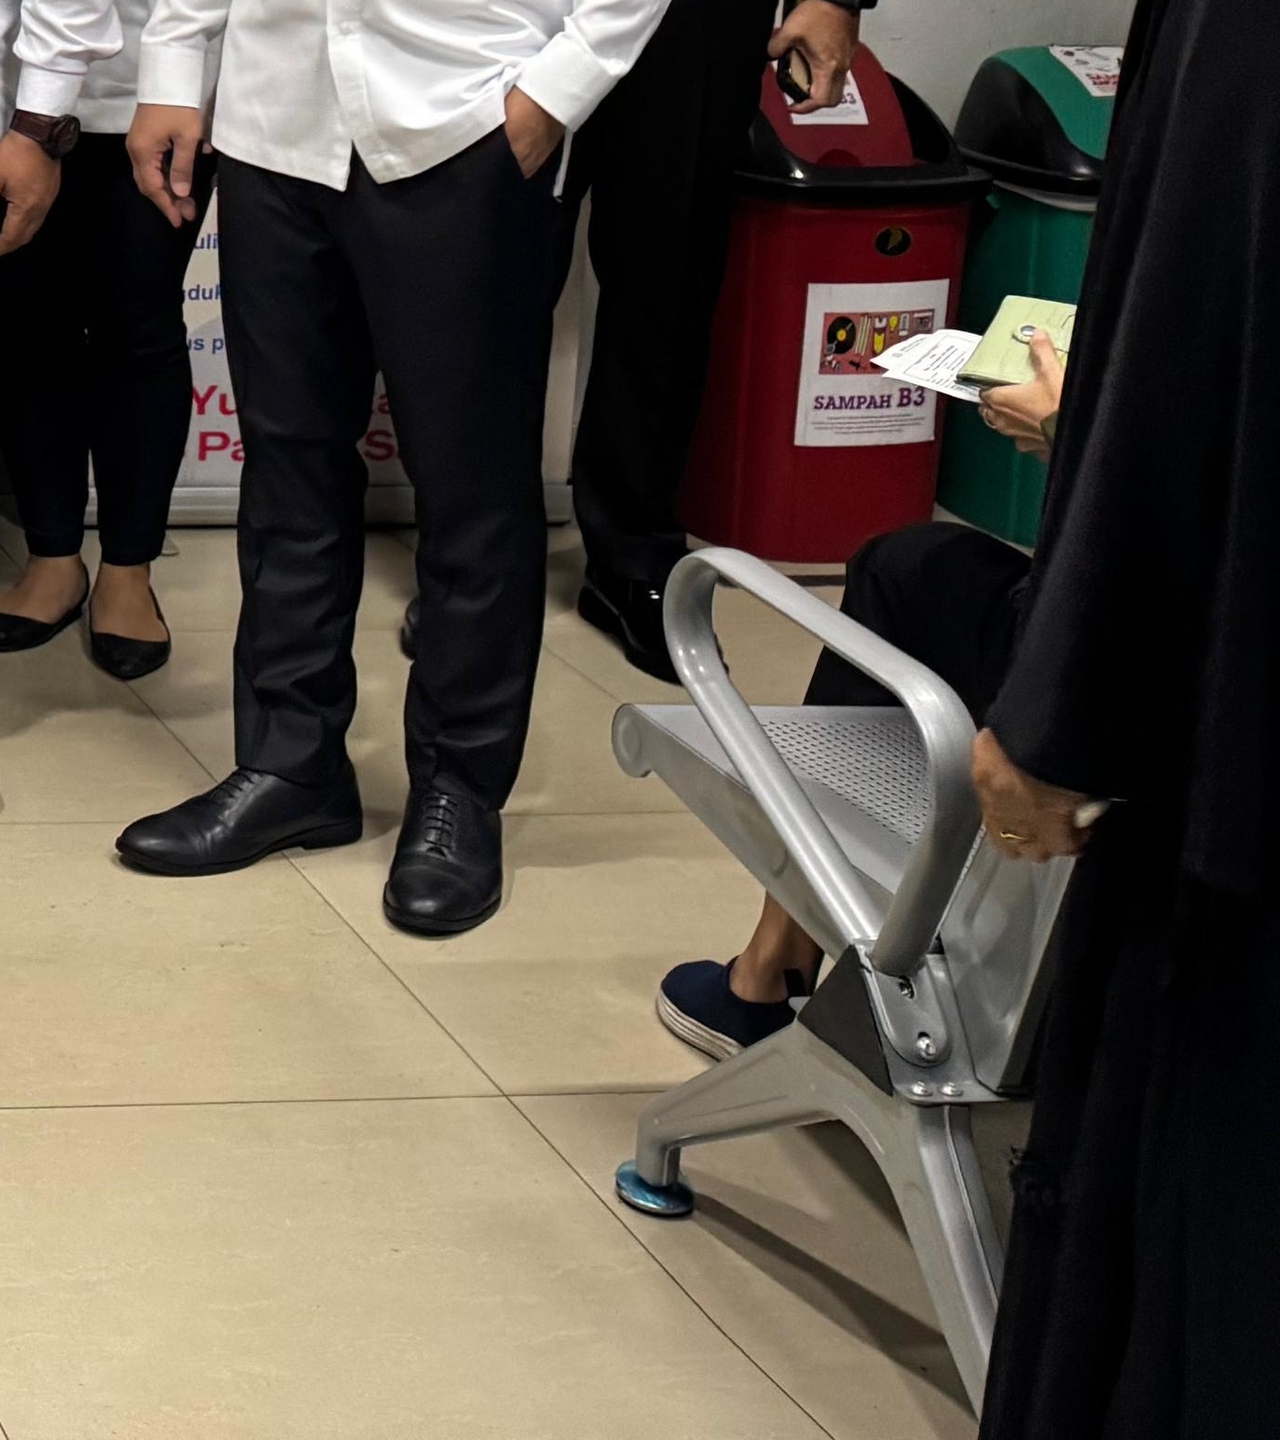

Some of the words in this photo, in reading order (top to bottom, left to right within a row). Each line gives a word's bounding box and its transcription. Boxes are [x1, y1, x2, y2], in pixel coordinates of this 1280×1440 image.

[814, 394, 892, 411] SAMPAH
[897, 386, 926, 407] B3
[365, 430, 394, 460] S
